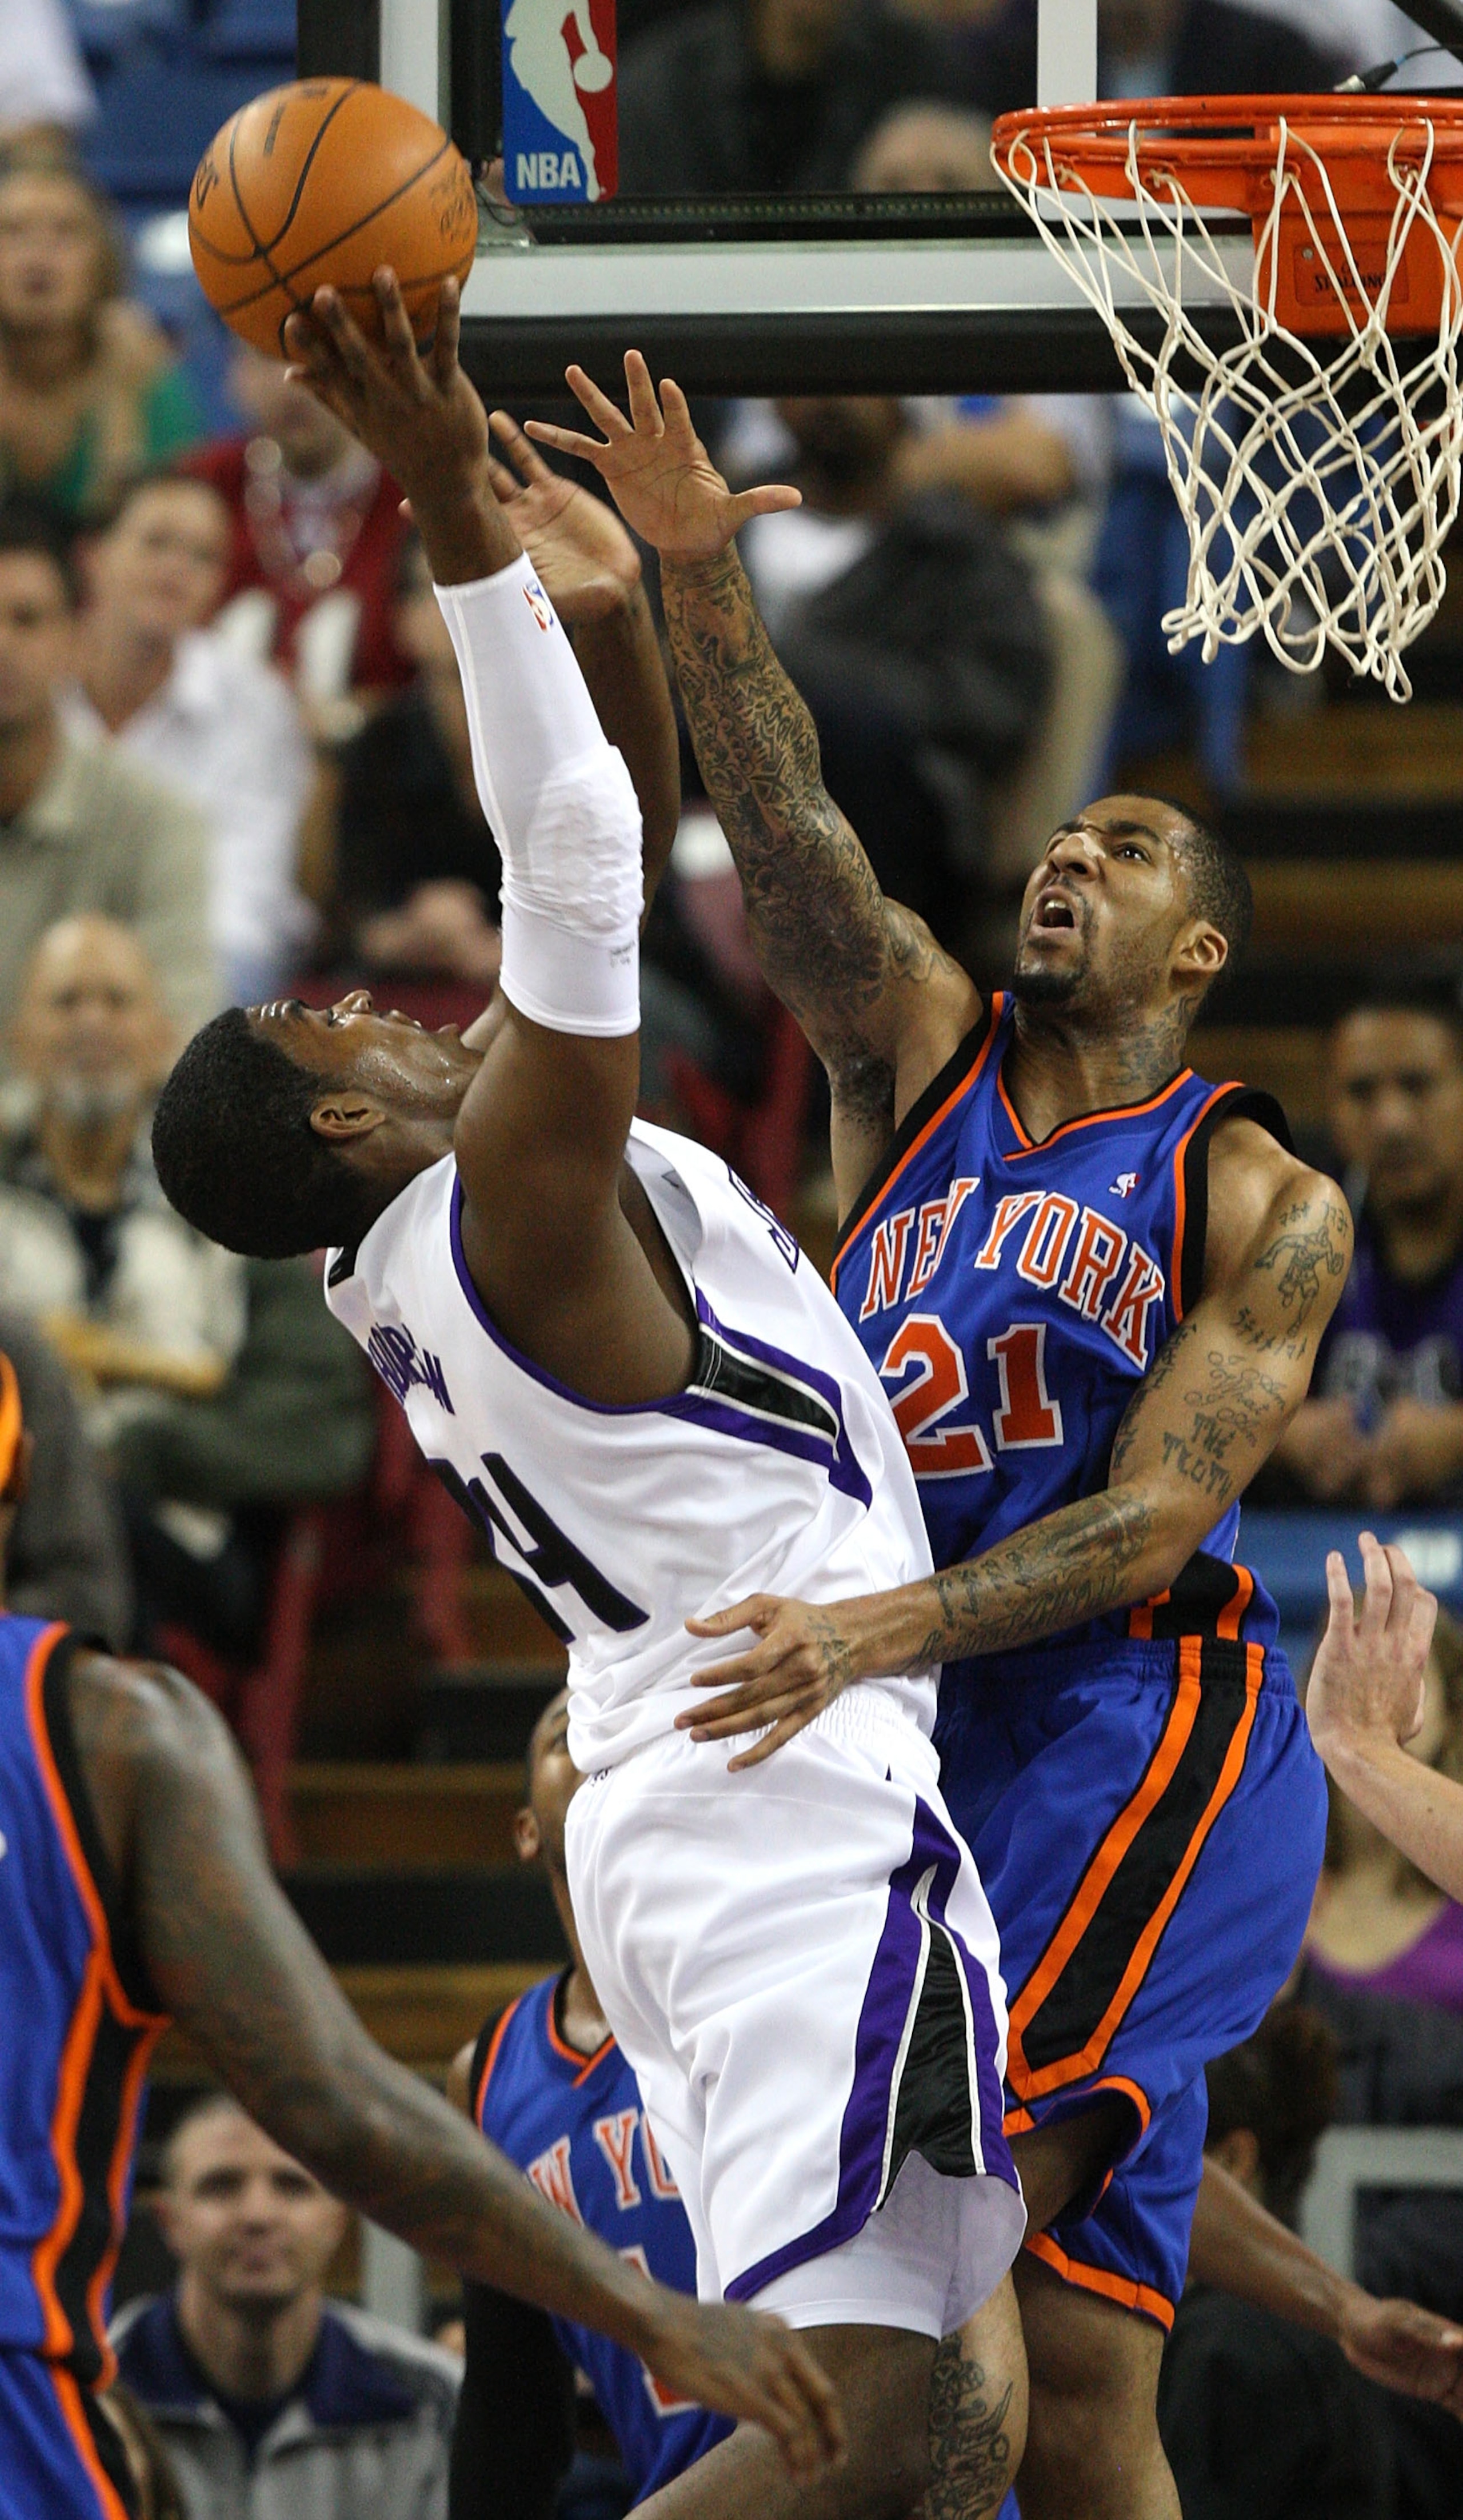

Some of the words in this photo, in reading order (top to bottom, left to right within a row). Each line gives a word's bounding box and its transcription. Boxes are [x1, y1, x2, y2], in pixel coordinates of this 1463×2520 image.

[517, 152, 581, 189] NBA
[1314, 274, 1389, 293] SPLDIN
[859, 1177, 980, 1323] NEW
[974, 1191, 1165, 1371] YORK
[878, 1313, 1064, 1480] 21
